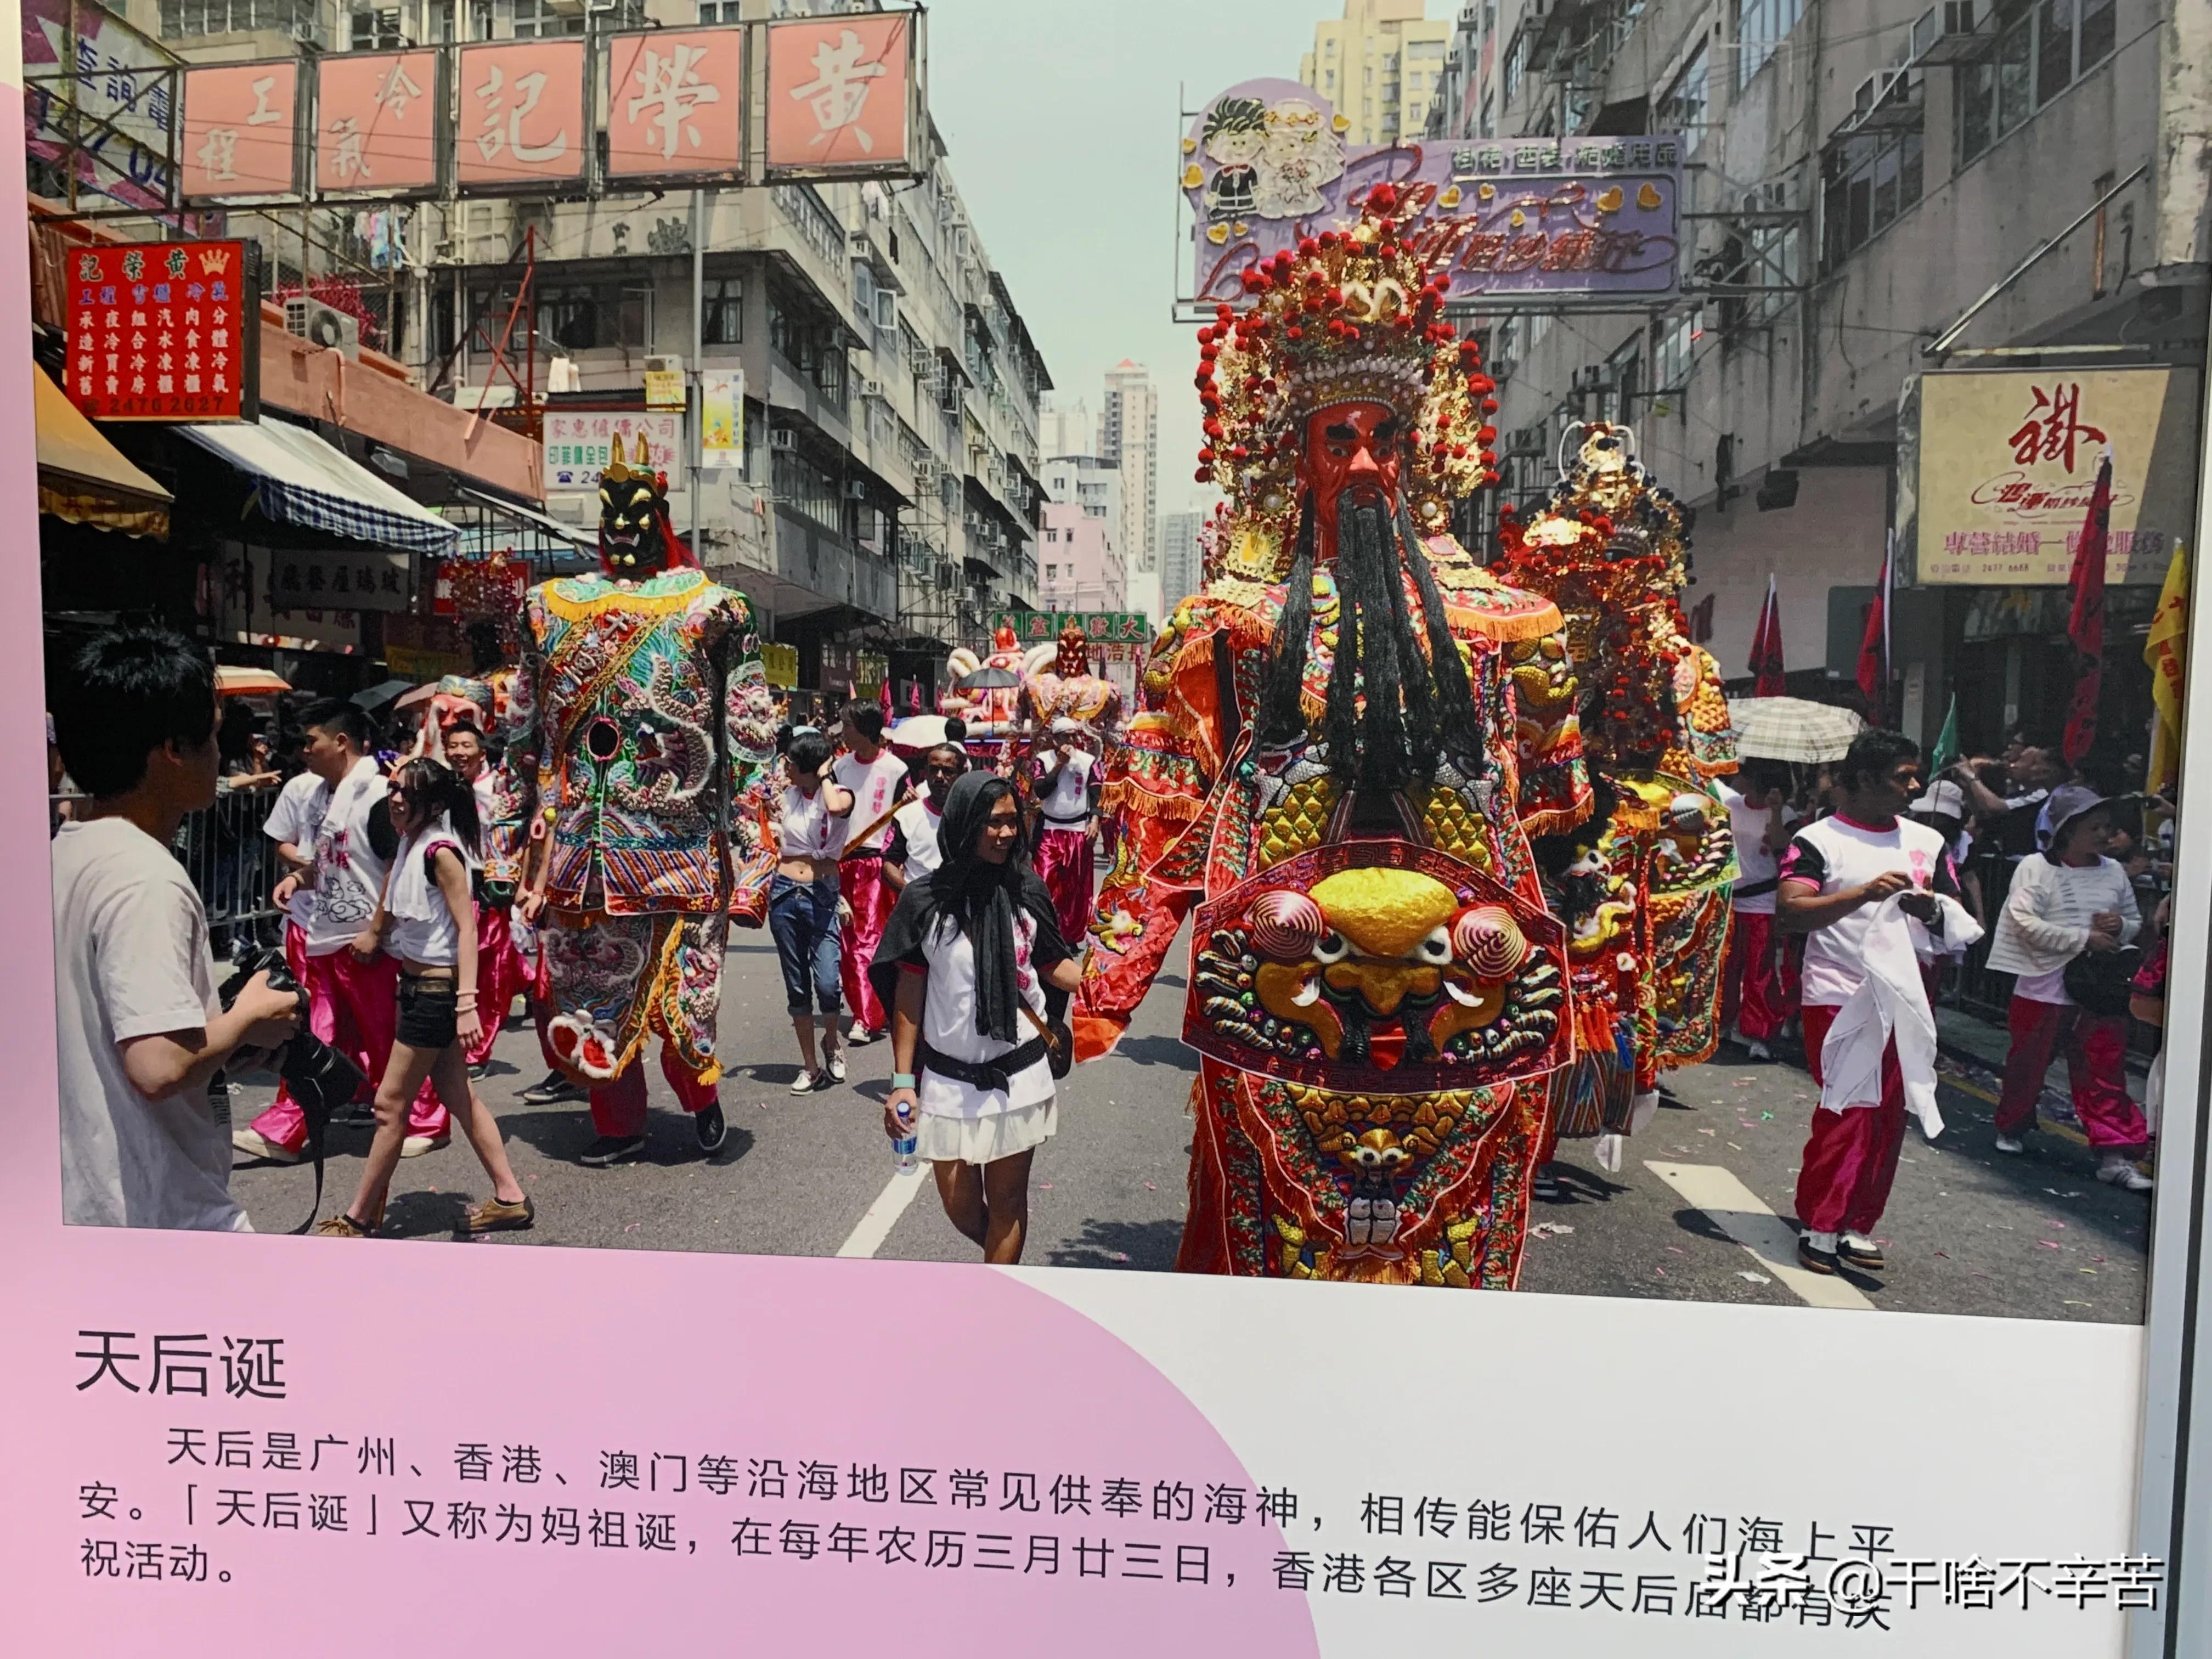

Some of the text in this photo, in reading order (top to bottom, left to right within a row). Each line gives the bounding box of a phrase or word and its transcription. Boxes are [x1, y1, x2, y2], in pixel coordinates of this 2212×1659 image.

[75, 1330, 286, 1399] 天后诞
[167, 1427, 1895, 1564] 天后是广州、香港、澳门等沿海地区常见供奉的海神，相传能保佑人们海上平
[81, 1538, 231, 1582] 祝活动。
